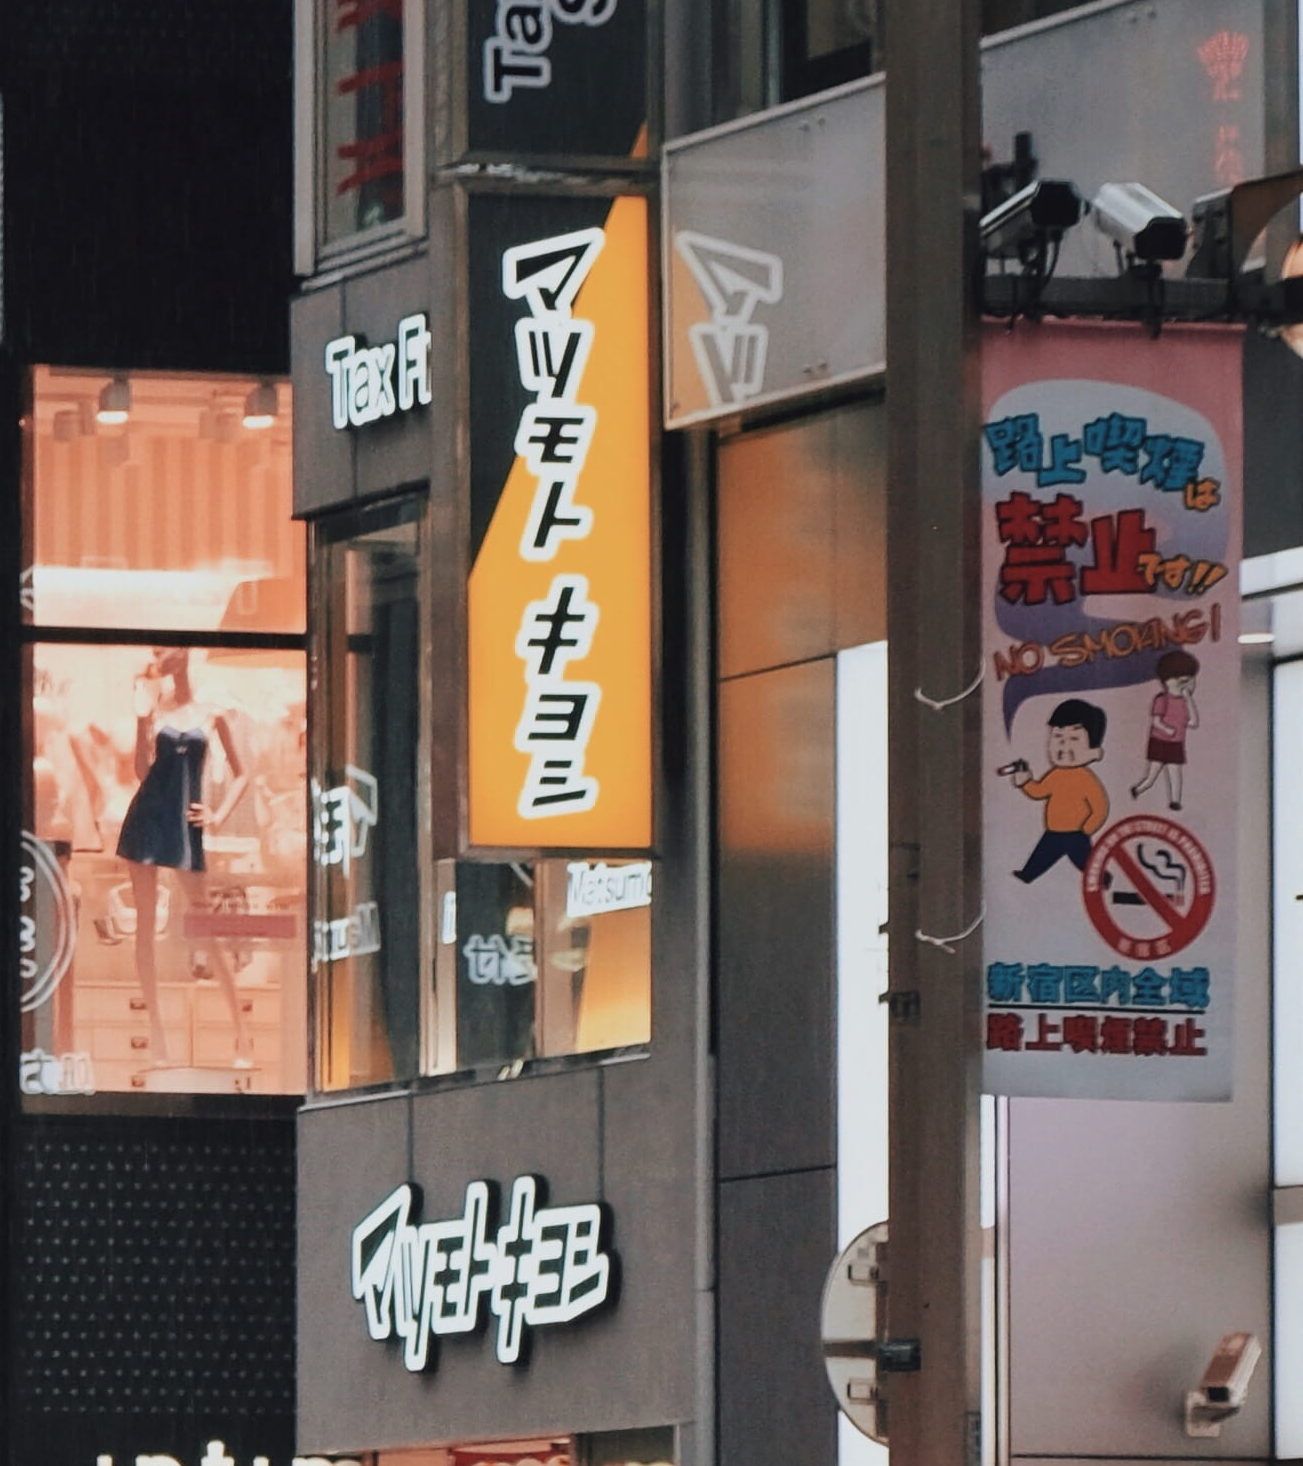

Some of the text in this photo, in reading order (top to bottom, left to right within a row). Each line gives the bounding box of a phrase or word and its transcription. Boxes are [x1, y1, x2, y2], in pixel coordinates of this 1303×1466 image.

[325, 334, 395, 430] Tax
[983, 412, 1222, 512] 路上喫煙は
[503, 228, 604, 819] マツモトキヨシ
[993, 642, 1043, 681] NO
[987, 961, 1211, 1009] 新宿区内全域
[986, 1012, 1208, 1057] 路上喫煙禁止
